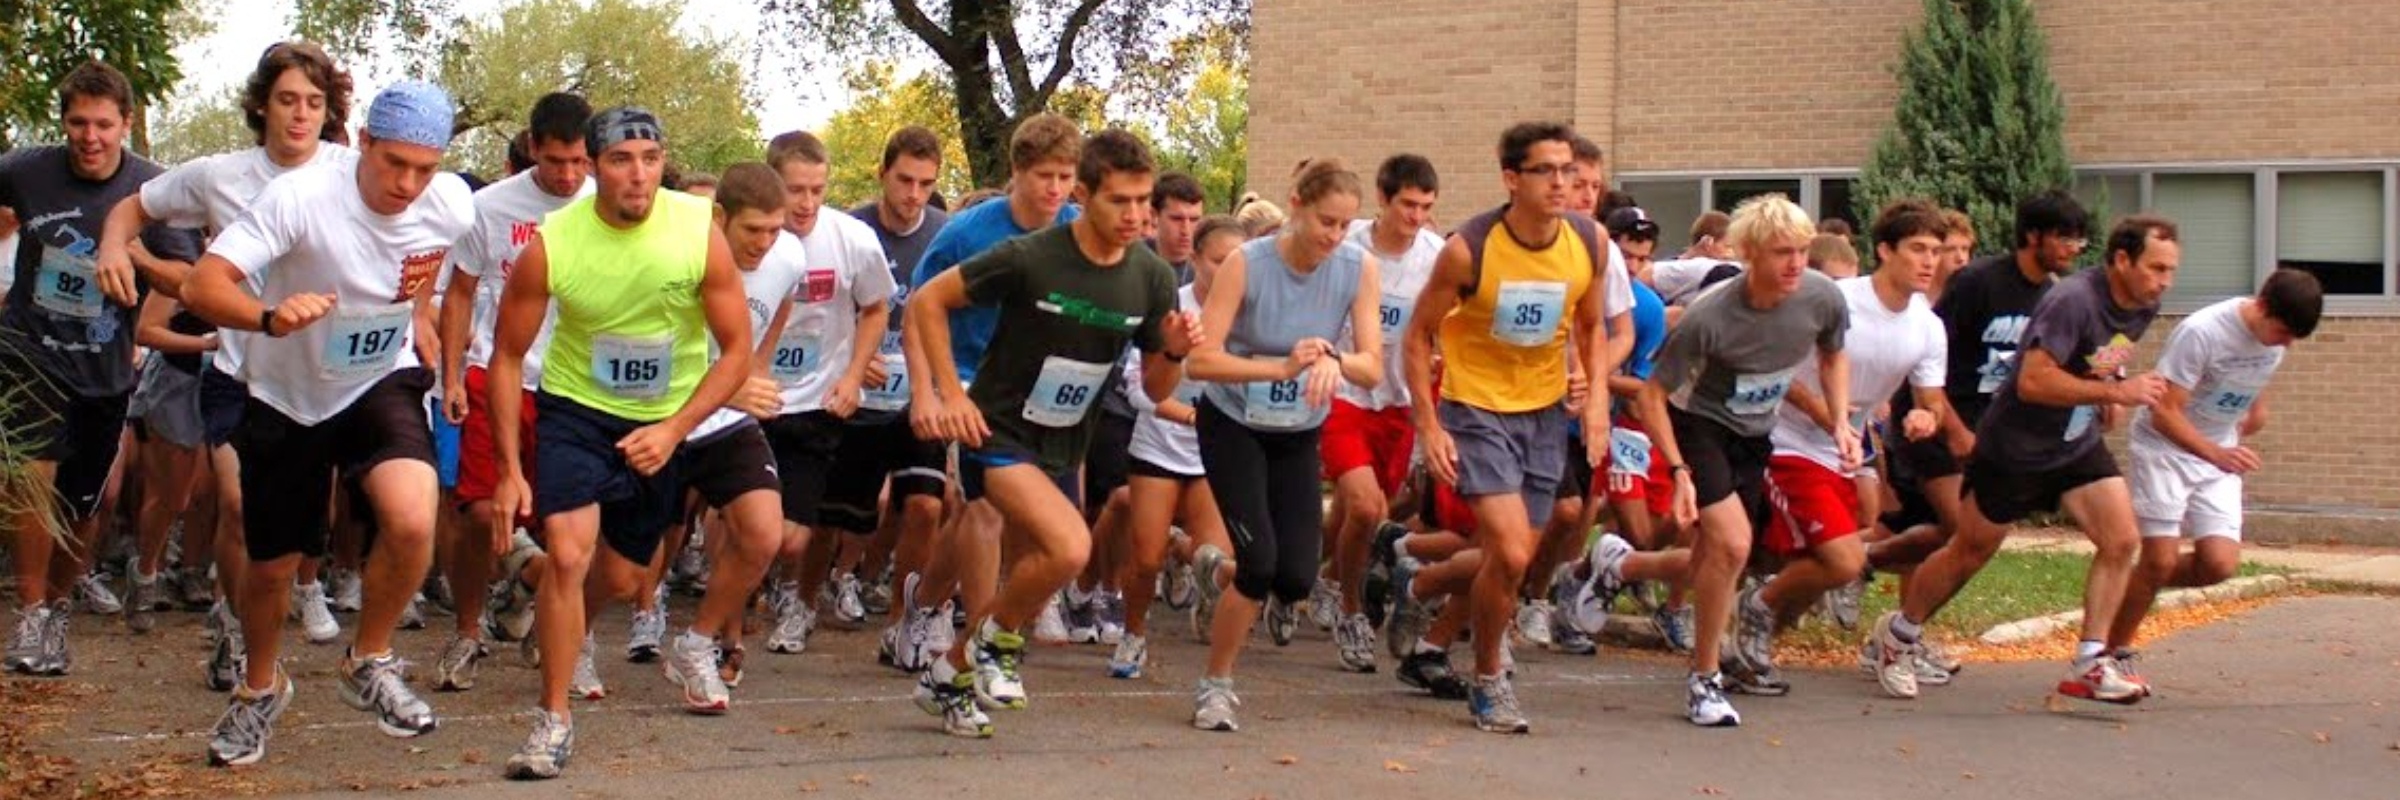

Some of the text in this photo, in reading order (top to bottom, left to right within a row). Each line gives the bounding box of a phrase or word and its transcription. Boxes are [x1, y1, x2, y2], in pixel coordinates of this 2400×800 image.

[56, 271, 85, 296] 92
[1514, 303, 1543, 326] 35
[347, 327, 398, 357] 197
[775, 347, 804, 368] 20
[609, 358, 659, 382] 165
[1055, 383, 1089, 406] 66
[1269, 379, 1298, 403] 63
